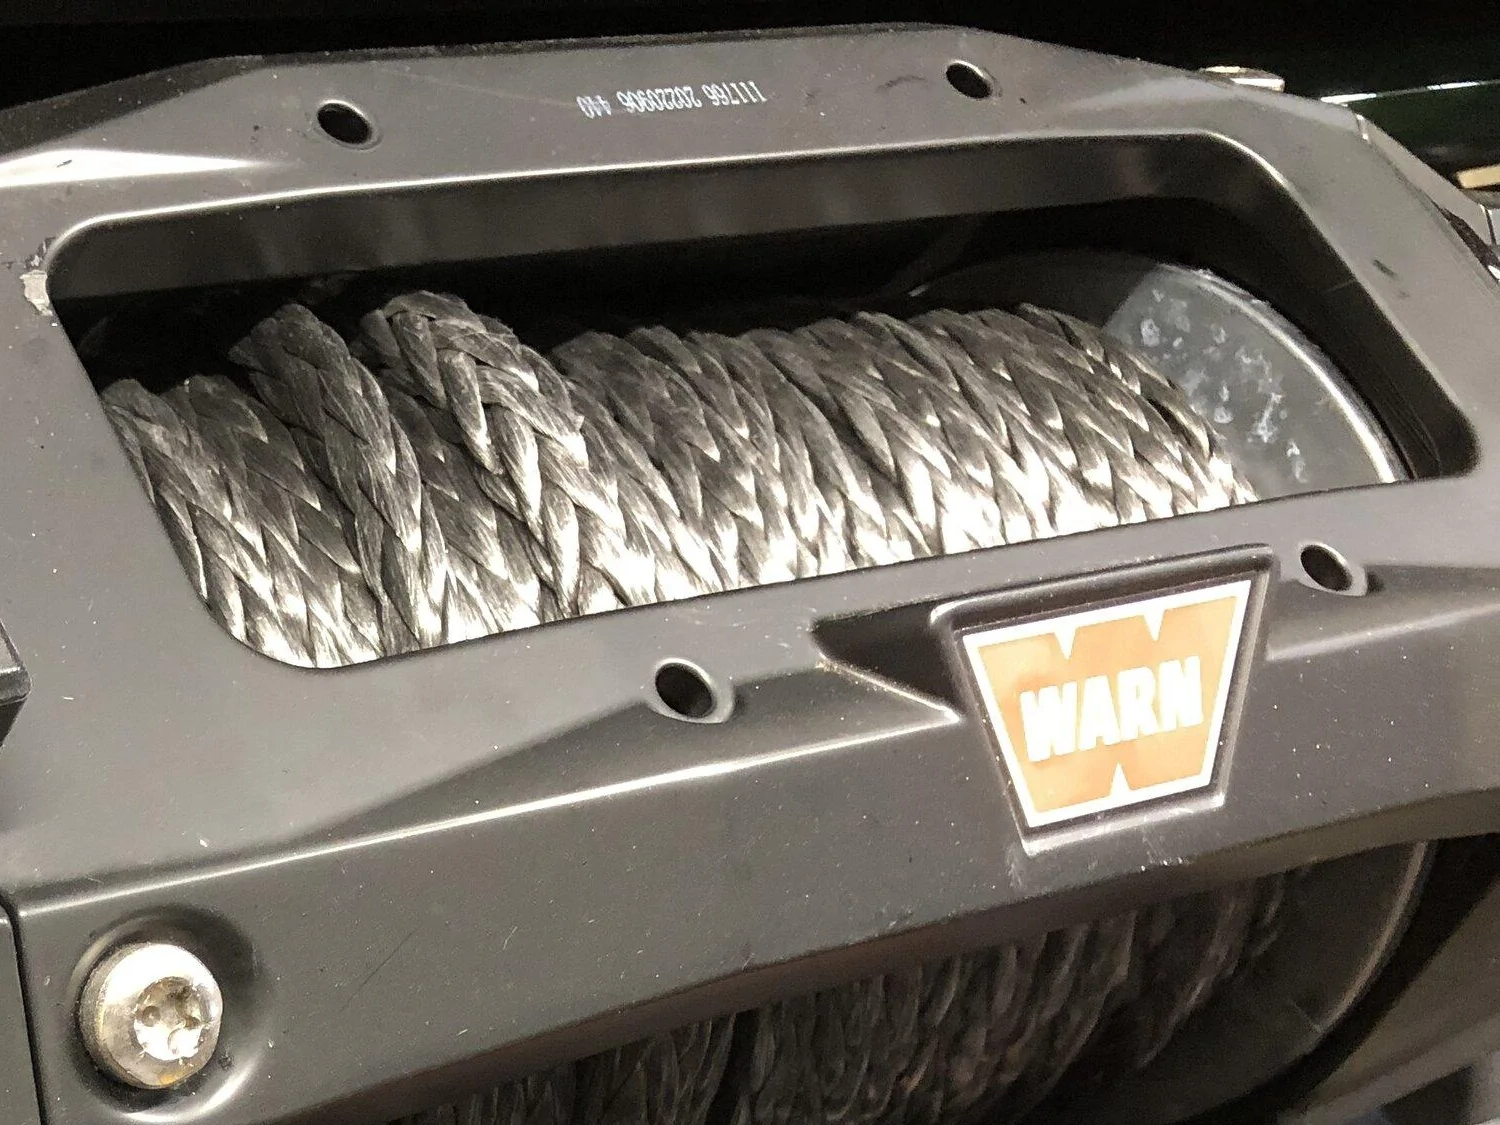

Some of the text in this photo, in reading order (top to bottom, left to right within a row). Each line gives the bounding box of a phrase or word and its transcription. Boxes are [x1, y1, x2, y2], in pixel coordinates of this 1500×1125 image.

[616, 85, 703, 114] 20220906
[701, 80, 768, 107] 111766
[1019, 655, 1204, 763] WARN
